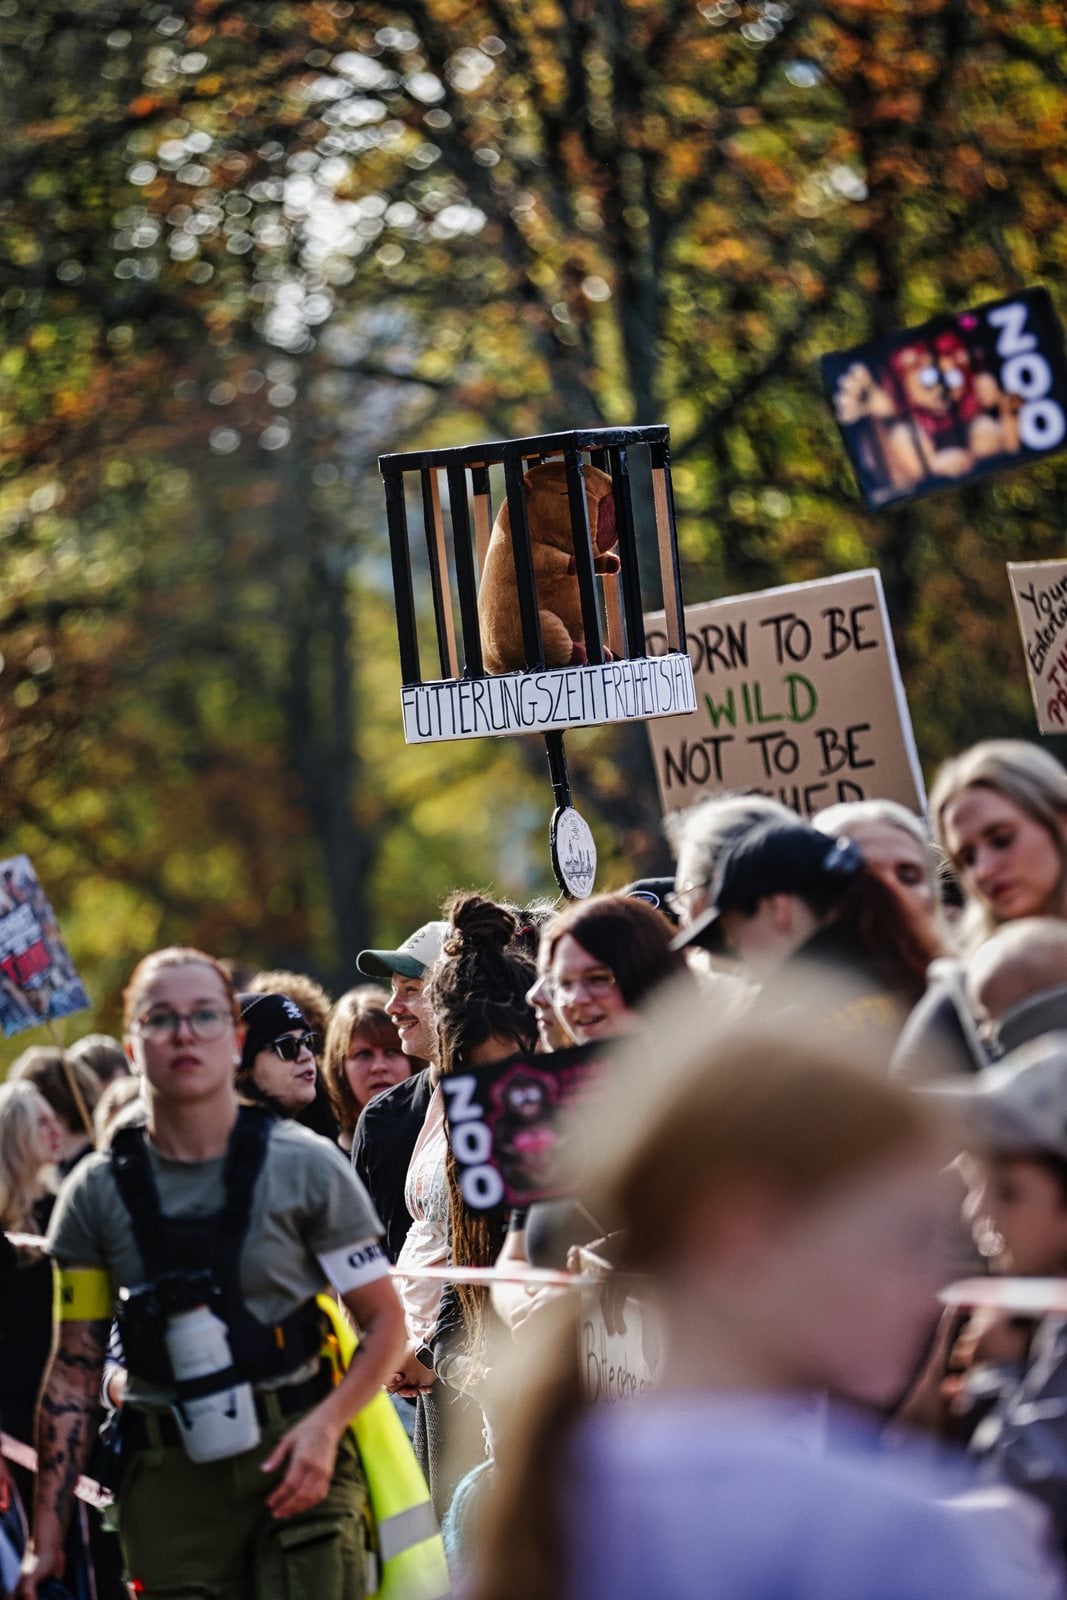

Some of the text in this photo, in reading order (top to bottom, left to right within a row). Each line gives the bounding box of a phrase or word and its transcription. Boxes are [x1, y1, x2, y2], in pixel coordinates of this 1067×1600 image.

[987, 302, 1066, 450] ZOO
[759, 612, 812, 664] TO
[822, 603, 879, 660] BE
[401, 669, 597, 738] FÜTTERUNGSZEIT
[703, 672, 819, 729] WILD
[664, 722, 876, 789] NOT TO BE
[442, 1074, 504, 1210] ZOO
[348, 1243, 386, 1269] OR
